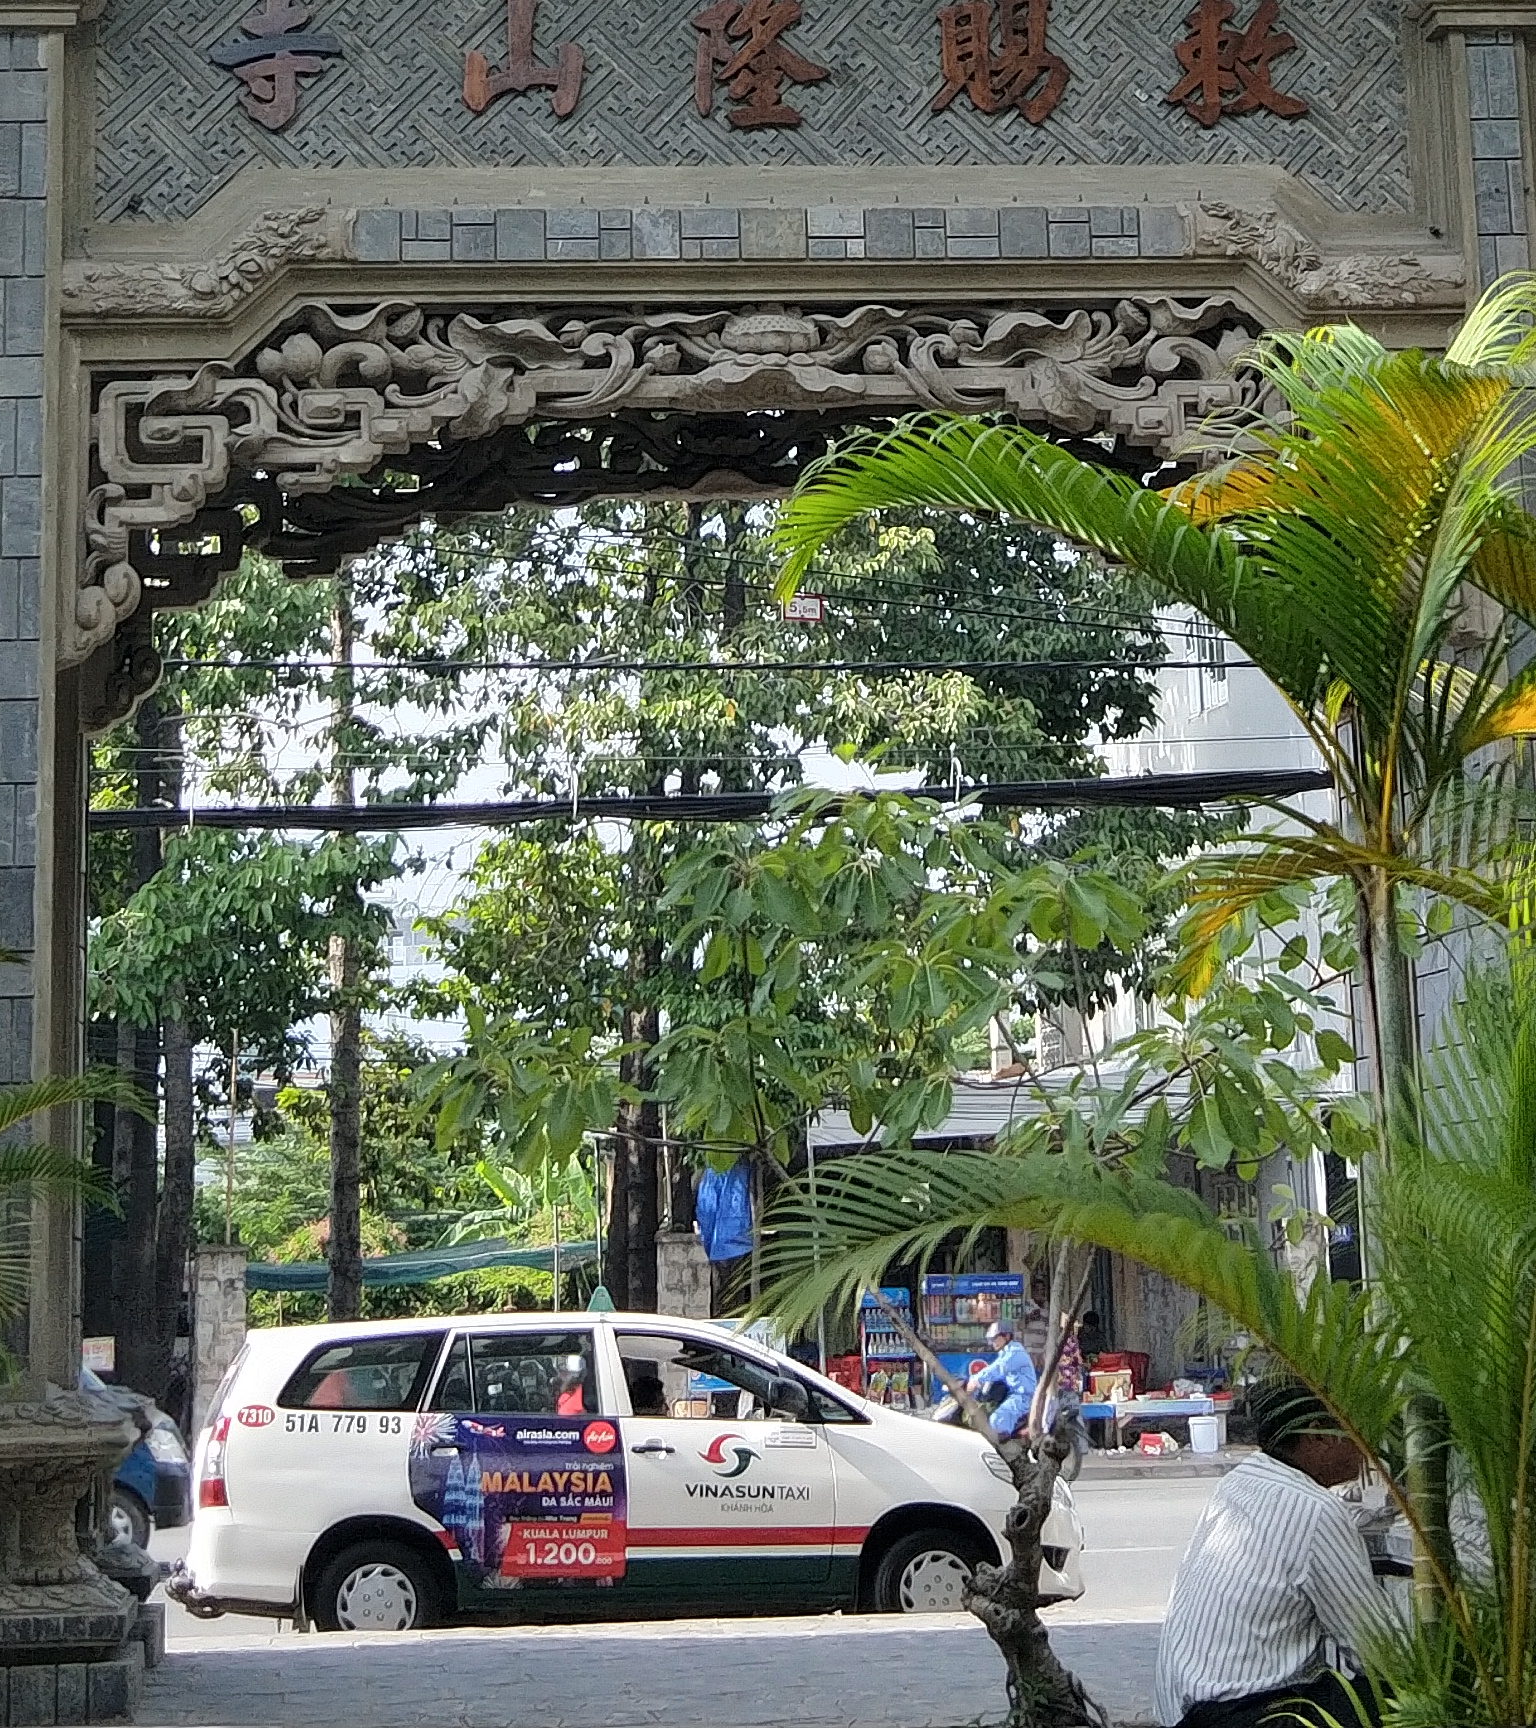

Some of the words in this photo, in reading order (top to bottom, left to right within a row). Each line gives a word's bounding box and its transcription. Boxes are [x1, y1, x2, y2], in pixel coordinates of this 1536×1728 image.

[240, 1409, 271, 1423] 7310
[285, 1414, 319, 1433] 51A
[332, 1415, 366, 1434] 779
[379, 1416, 401, 1434] 93
[516, 1428, 580, 1441] airasia.com
[481, 1472, 613, 1493] MALAYSIA
[523, 1528, 560, 1539] KUALA
[562, 1528, 608, 1539] LUMPUR
